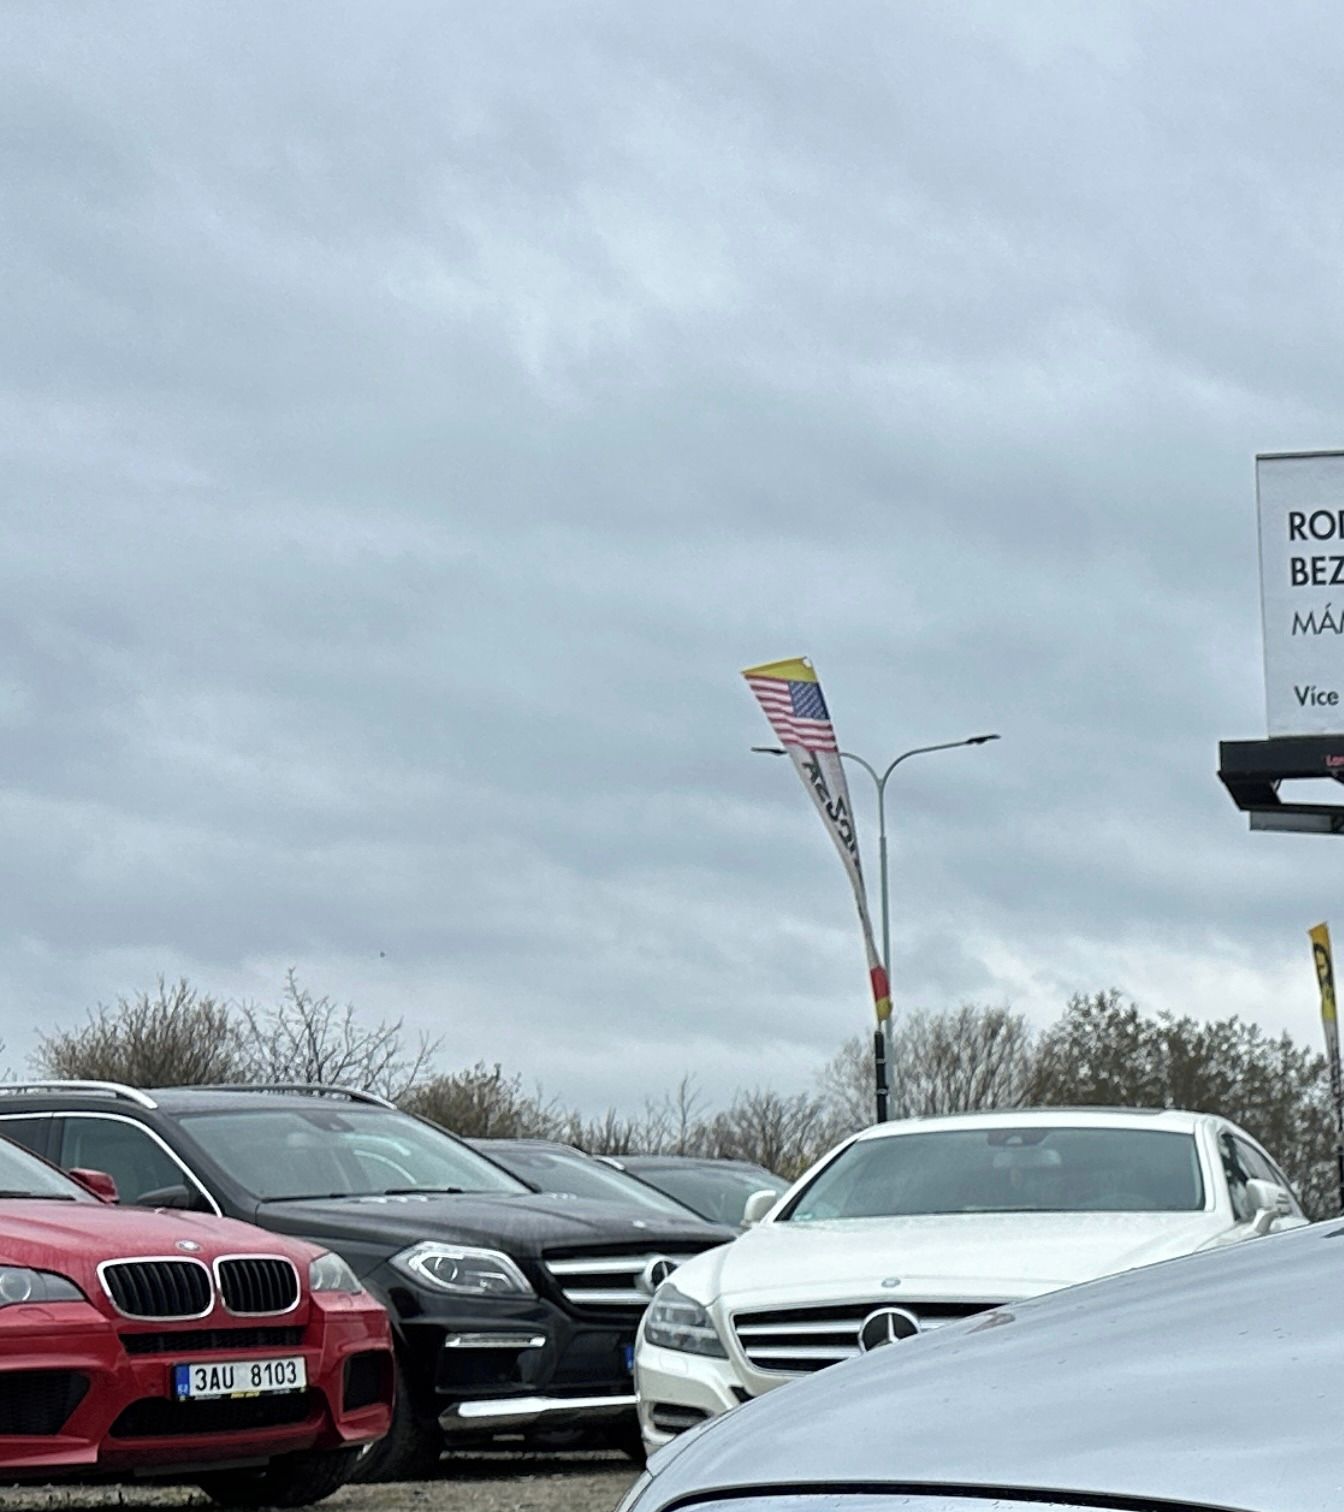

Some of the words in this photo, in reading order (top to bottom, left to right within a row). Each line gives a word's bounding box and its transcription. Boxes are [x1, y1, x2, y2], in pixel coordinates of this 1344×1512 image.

[1293, 684, 1339, 707] Více
[195, 1365, 235, 1391] 3AU
[250, 1360, 298, 1388] 8103
